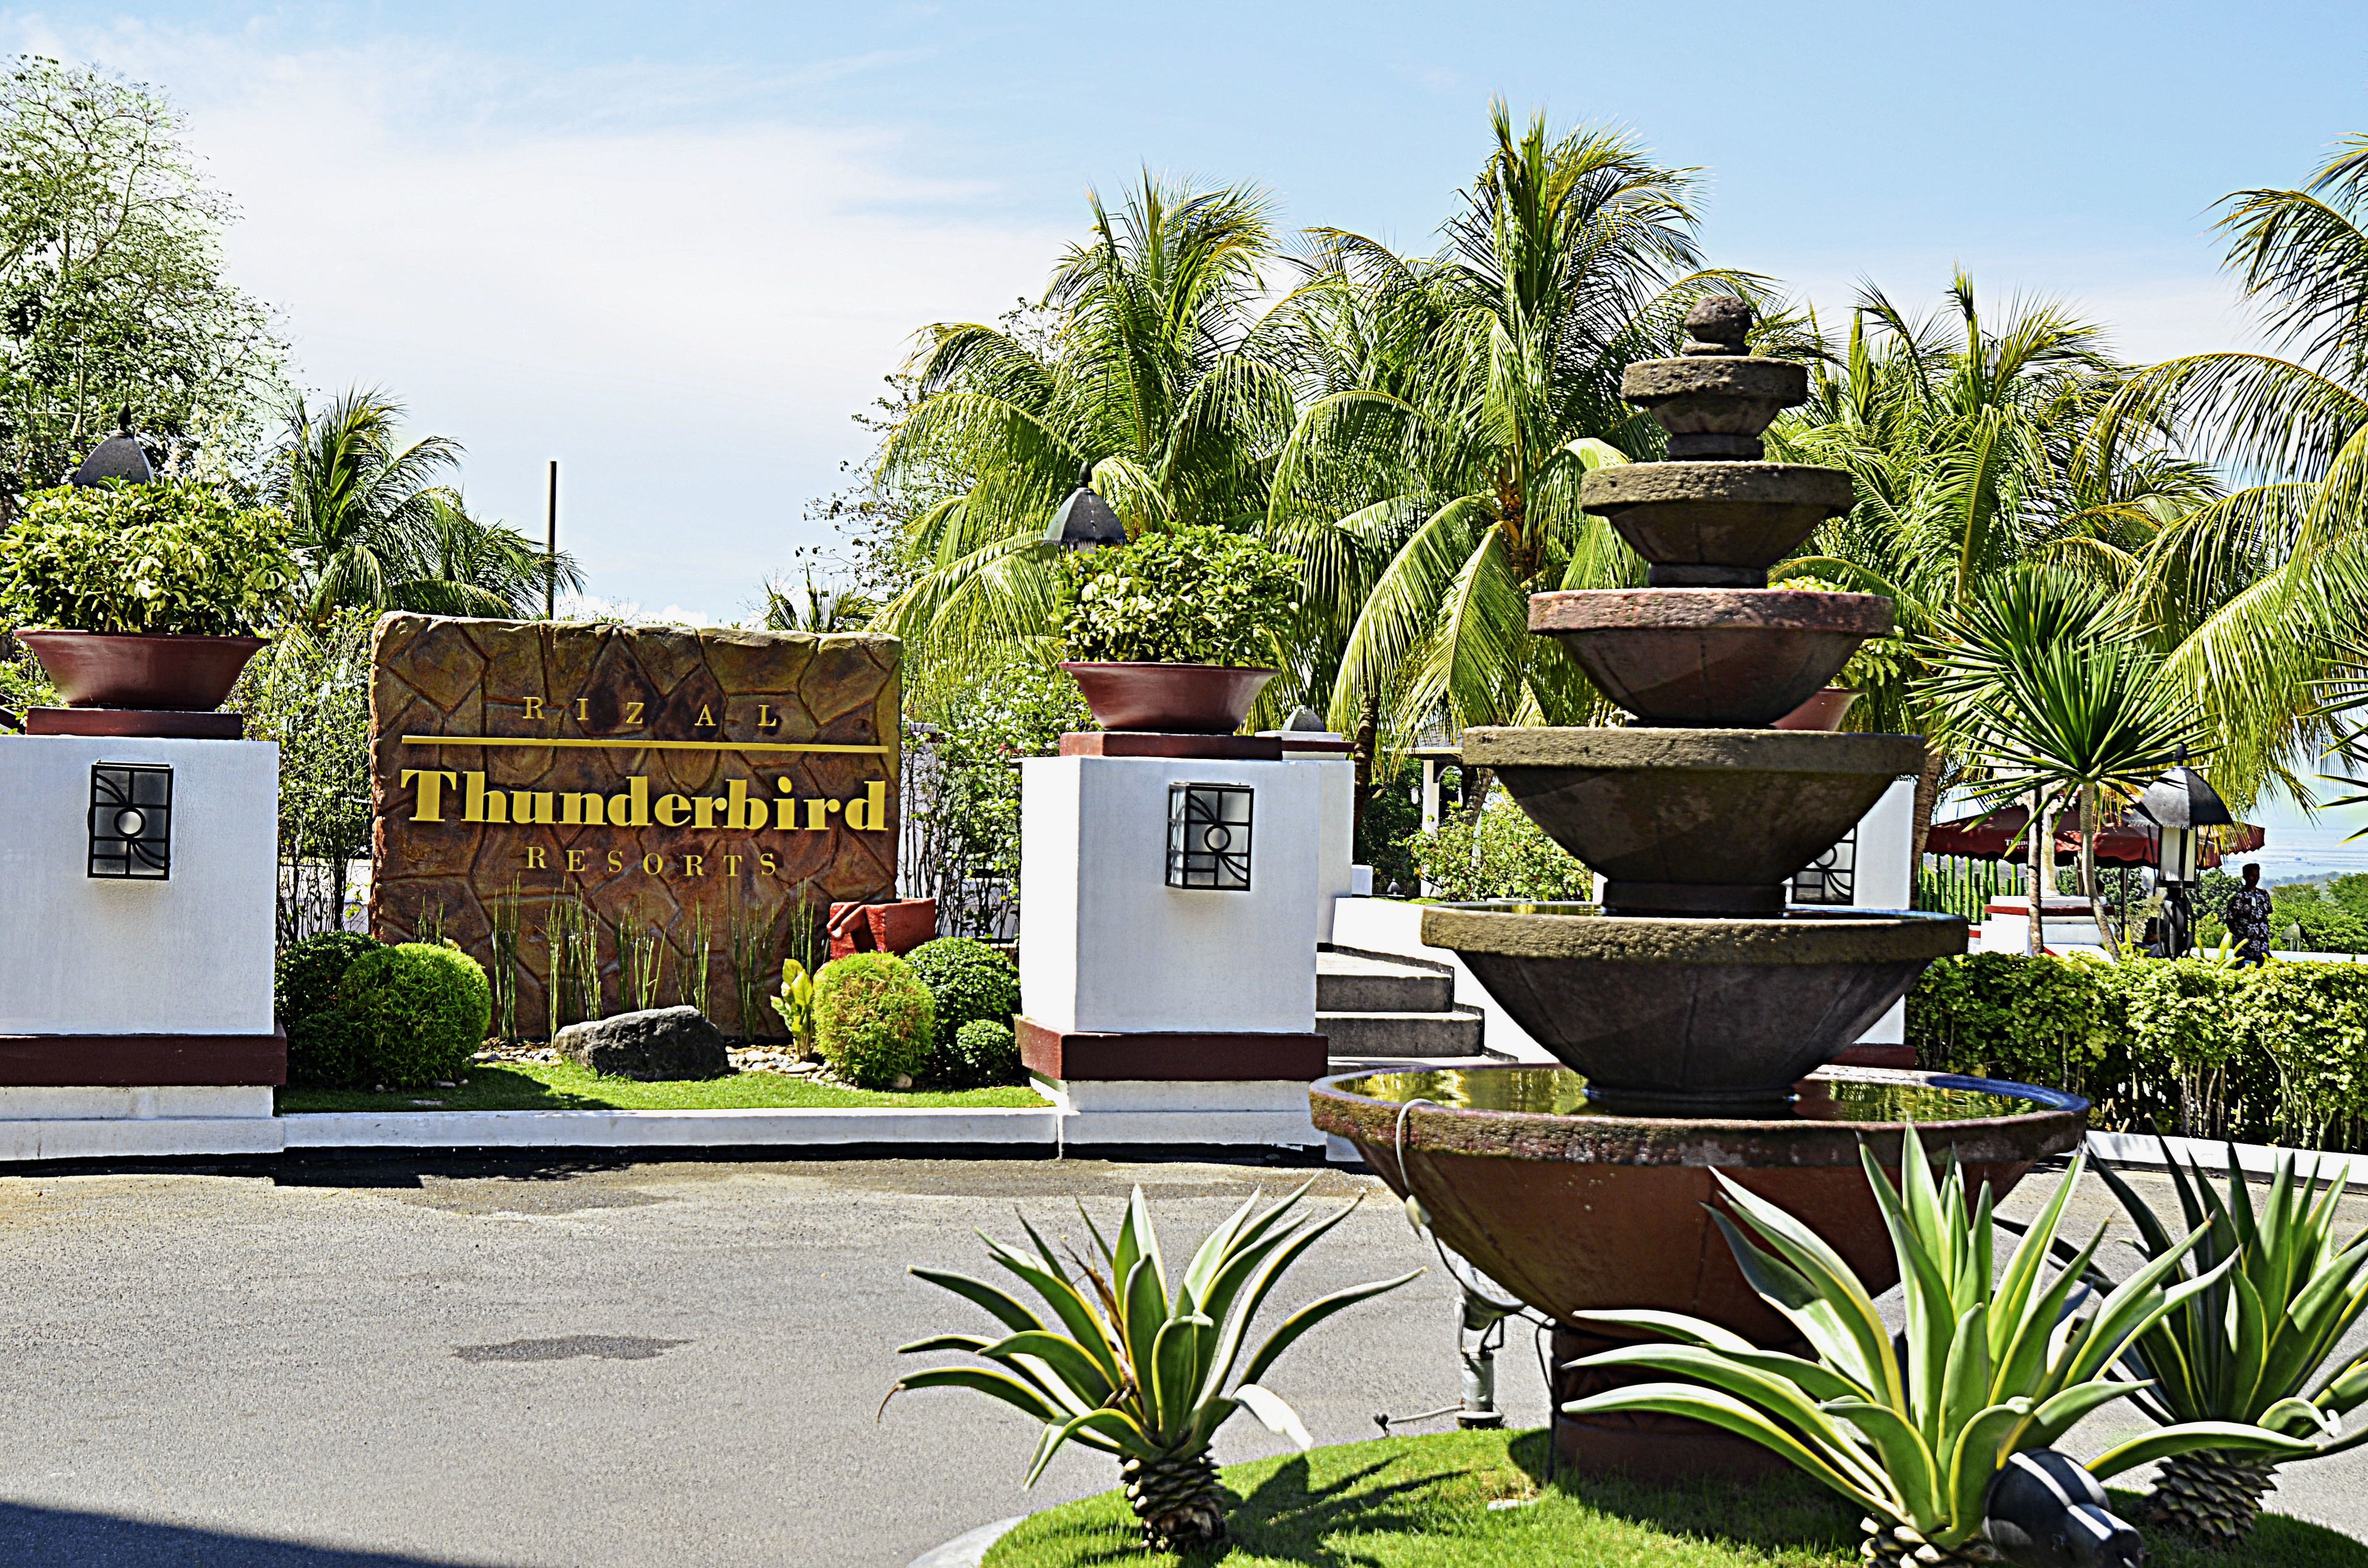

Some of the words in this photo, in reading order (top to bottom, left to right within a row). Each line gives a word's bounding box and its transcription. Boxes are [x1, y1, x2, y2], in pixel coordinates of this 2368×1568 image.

[522, 696, 777, 727] RIZAL
[400, 770, 889, 831] Thunderbird
[525, 846, 776, 877] RESORTS
